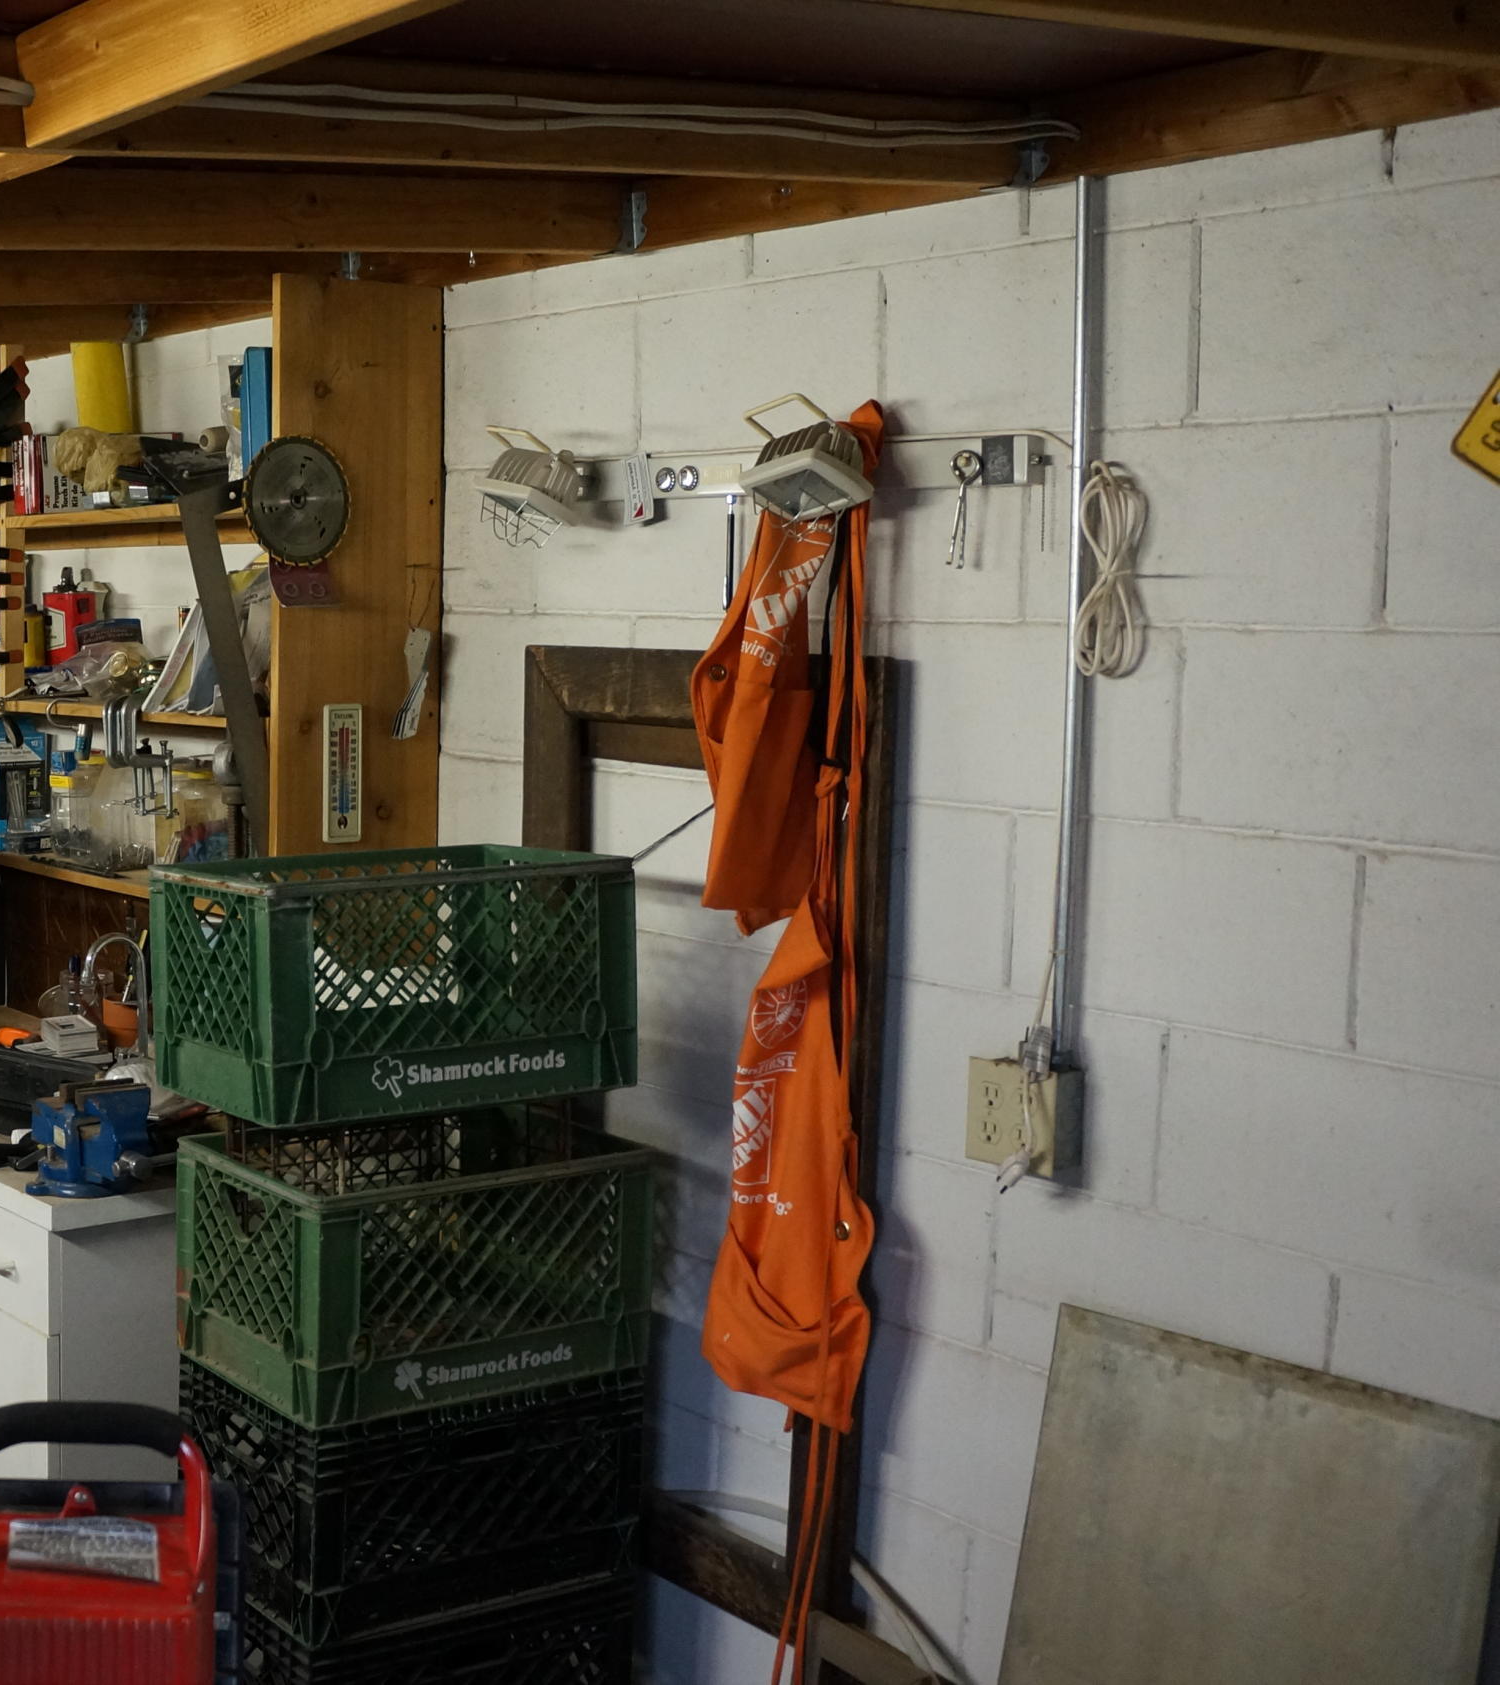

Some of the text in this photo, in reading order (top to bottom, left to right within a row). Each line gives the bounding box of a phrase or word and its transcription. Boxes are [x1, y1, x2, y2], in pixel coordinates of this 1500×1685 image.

[53, 476, 62, 509] Propane
[61, 488, 69, 508] Torch
[71, 496, 79, 508] Kit
[406, 1049, 566, 1085] Shamrock Foods
[426, 1343, 573, 1386] Shamrock Foods
